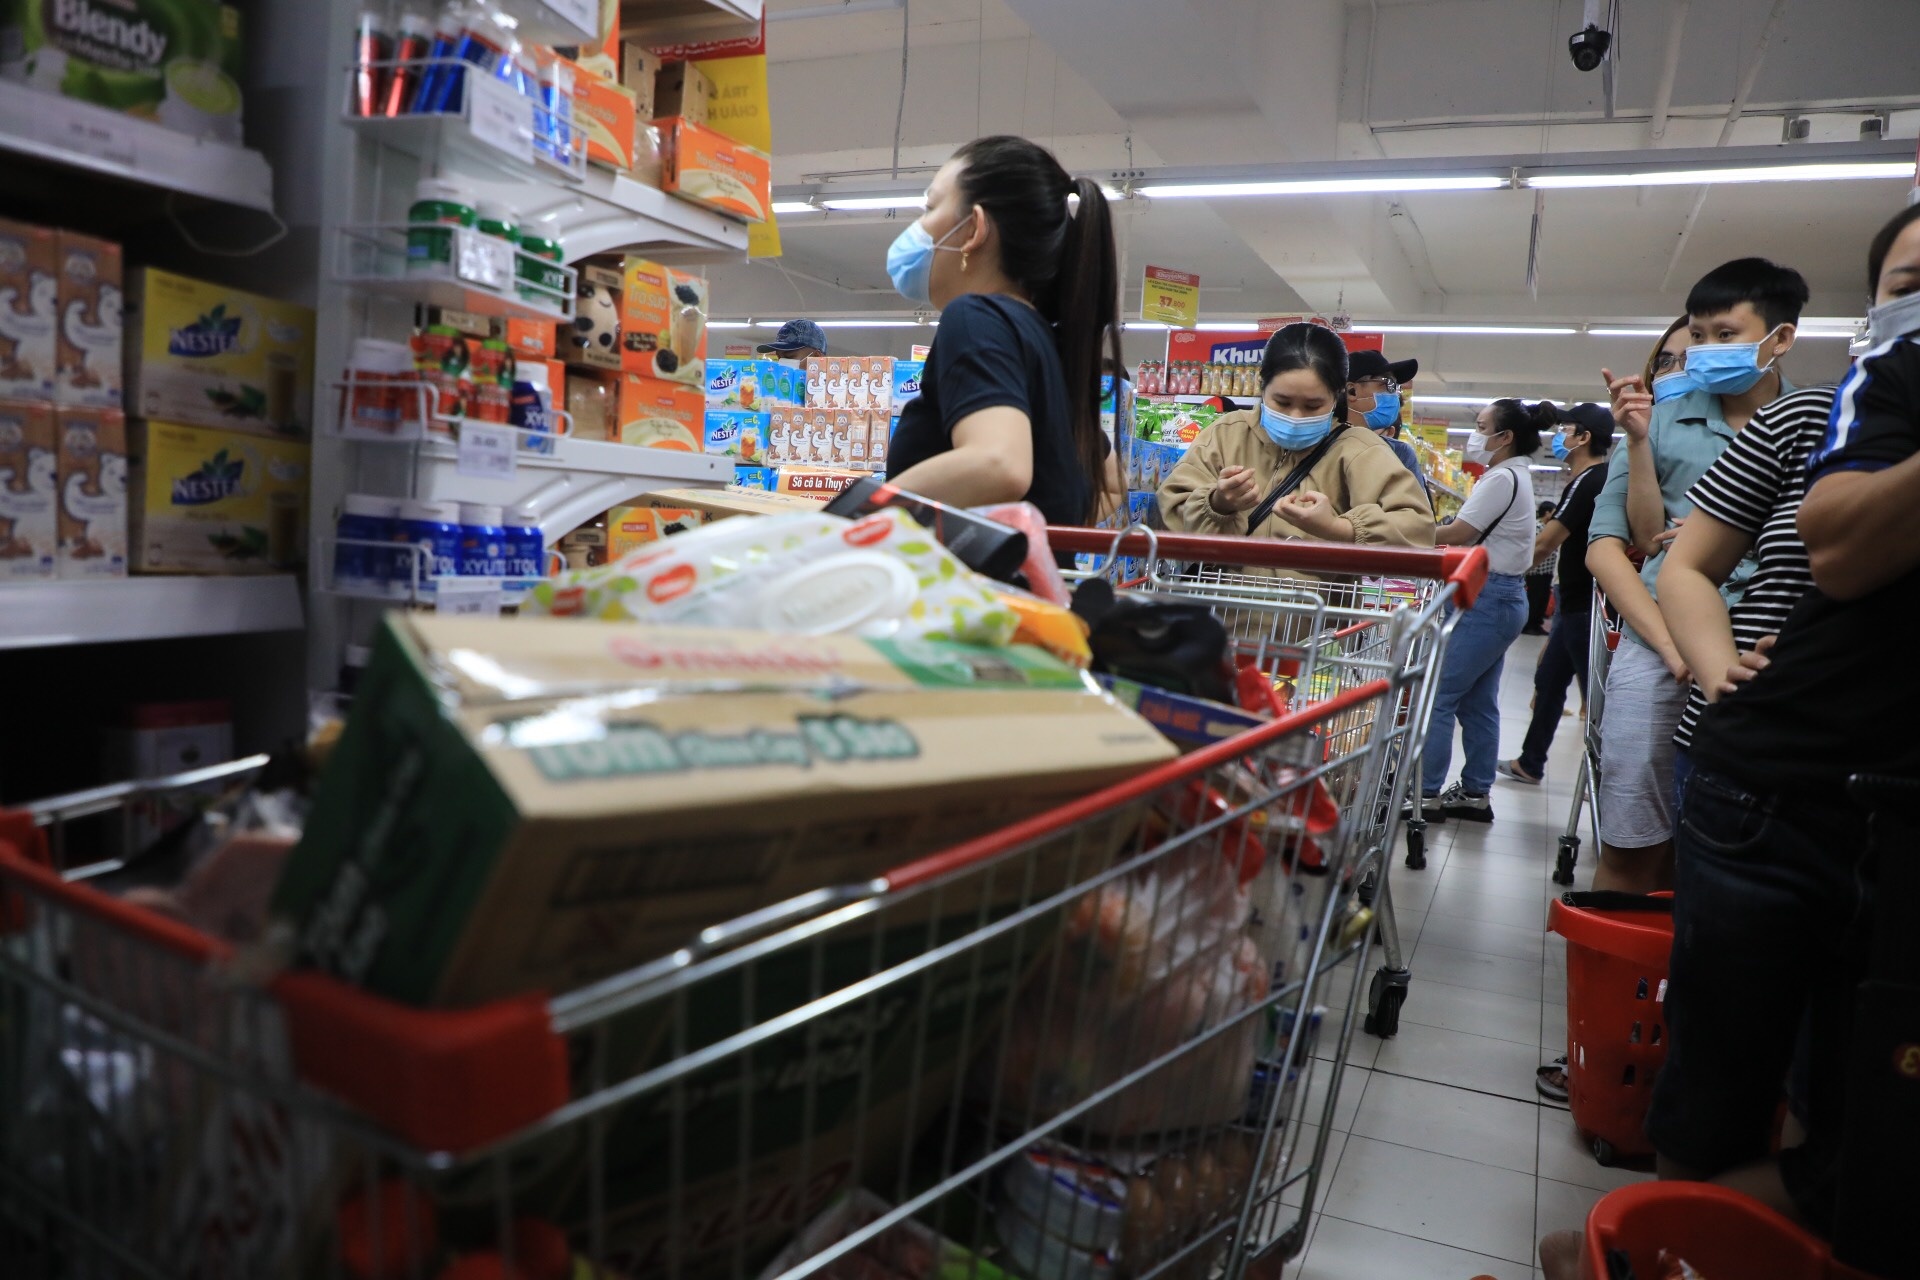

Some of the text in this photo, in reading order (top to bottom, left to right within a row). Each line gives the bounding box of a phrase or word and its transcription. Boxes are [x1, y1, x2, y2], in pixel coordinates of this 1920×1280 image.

[170, 329, 241, 352] NESTEA
[1213, 346, 1265, 365] Khuy
[711, 378, 737, 388] NESTEA
[901, 382, 921, 392] NEST
[712, 430, 738, 441] NESTEA
[172, 477, 244, 500] NESTEA
[792, 476, 802, 488] Sô
[804, 477, 814, 488] cô
[815, 477, 823, 489] la
[824, 477, 843, 492] Thụy
